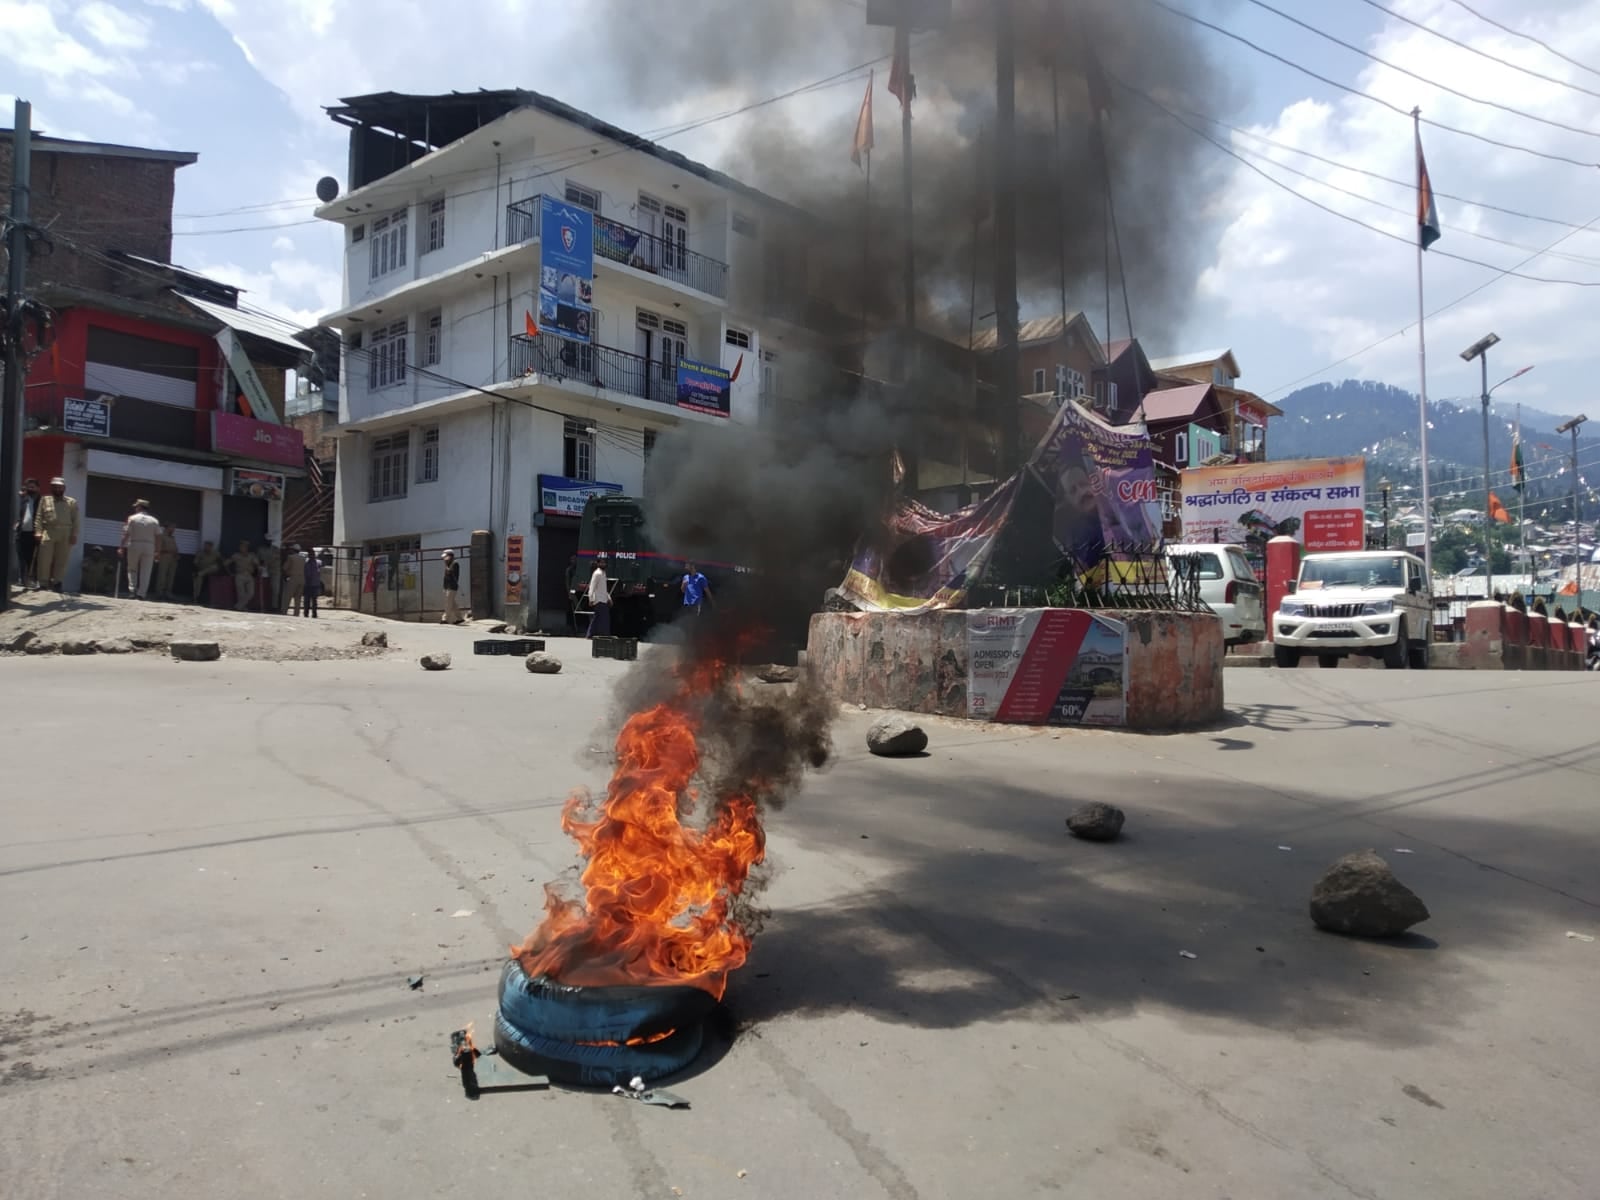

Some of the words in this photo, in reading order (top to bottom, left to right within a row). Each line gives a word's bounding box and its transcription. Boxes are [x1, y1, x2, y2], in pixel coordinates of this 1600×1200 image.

[253, 430, 272, 444] Jio
[558, 495, 587, 505] BROADW
[1185, 487, 1251, 507] श्रद्धांजलि
[1255, 491, 1267, 502] व
[1271, 486, 1321, 502] संकल्प
[1326, 486, 1361, 499] सभा
[615, 551, 637, 560] POLICE
[987, 615, 1016, 626] RIMT
[974, 649, 1021, 659] ADMISSIONS
[974, 660, 994, 669] OPEN
[1061, 704, 1083, 716] 60%
